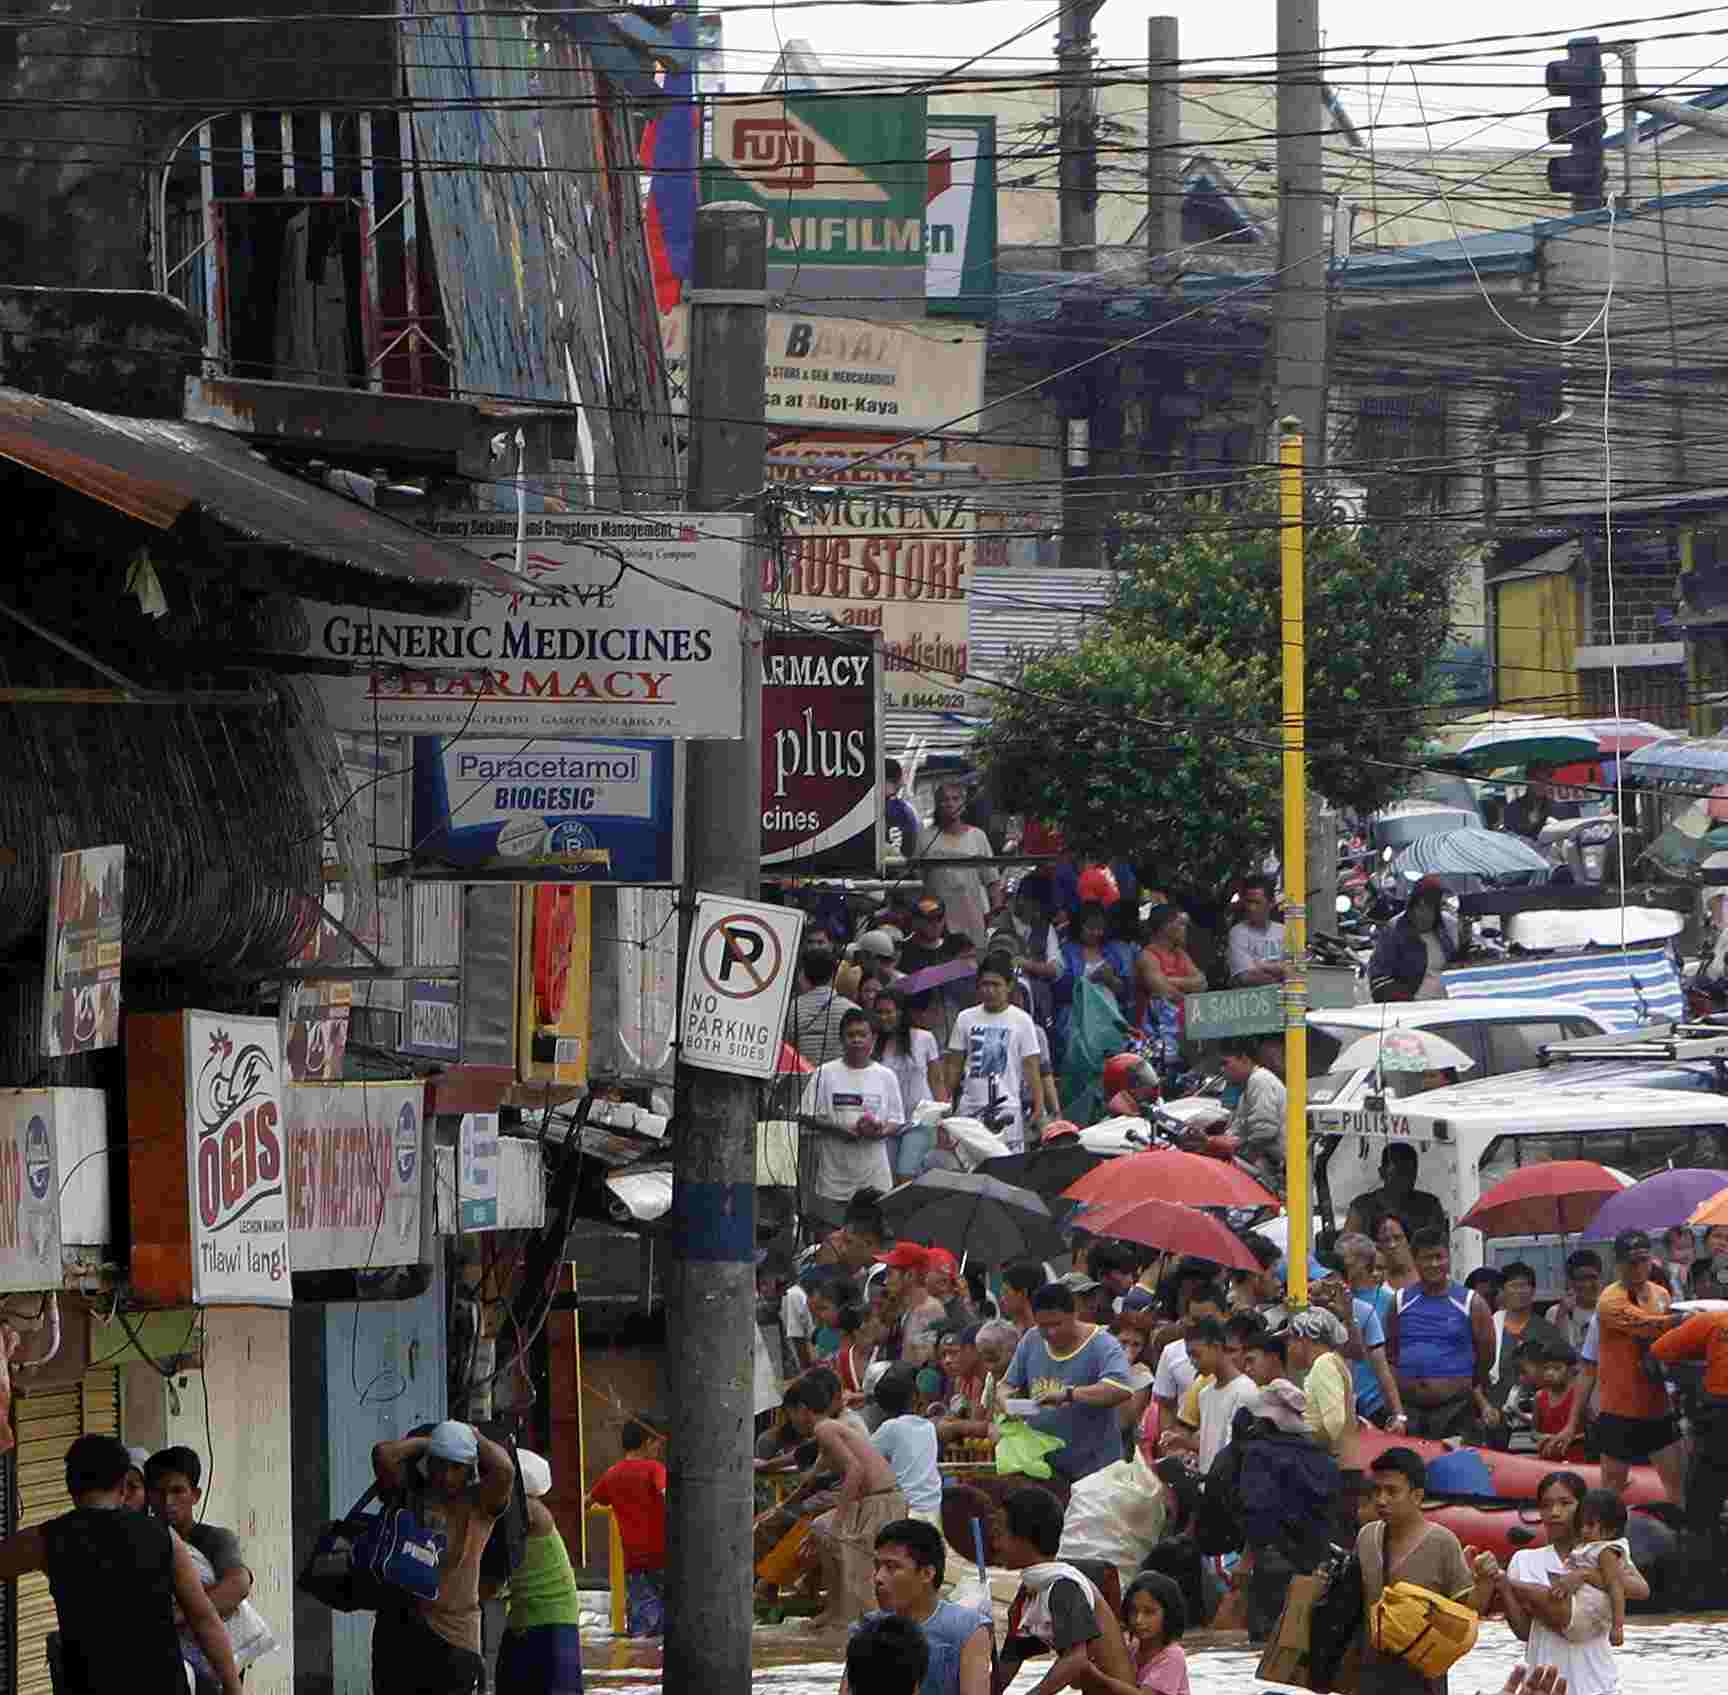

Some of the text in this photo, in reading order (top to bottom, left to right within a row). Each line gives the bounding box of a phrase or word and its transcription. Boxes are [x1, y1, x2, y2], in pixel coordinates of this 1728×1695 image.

[767, 217, 921, 252] JIFILM
[862, 539, 966, 601] STORE
[323, 614, 713, 662] GENERIC MEDICINES
[760, 655, 869, 687] RMACY
[774, 706, 866, 797] plus
[458, 754, 637, 780] Paracetamol
[495, 786, 597, 811] BIOGESIC
[761, 810, 820, 832] cines
[690, 993, 718, 1015] NO
[686, 1014, 769, 1046] PARKING
[686, 1036, 767, 1063] BOTH SIDES
[1342, 1111, 1411, 1136] PULISYA
